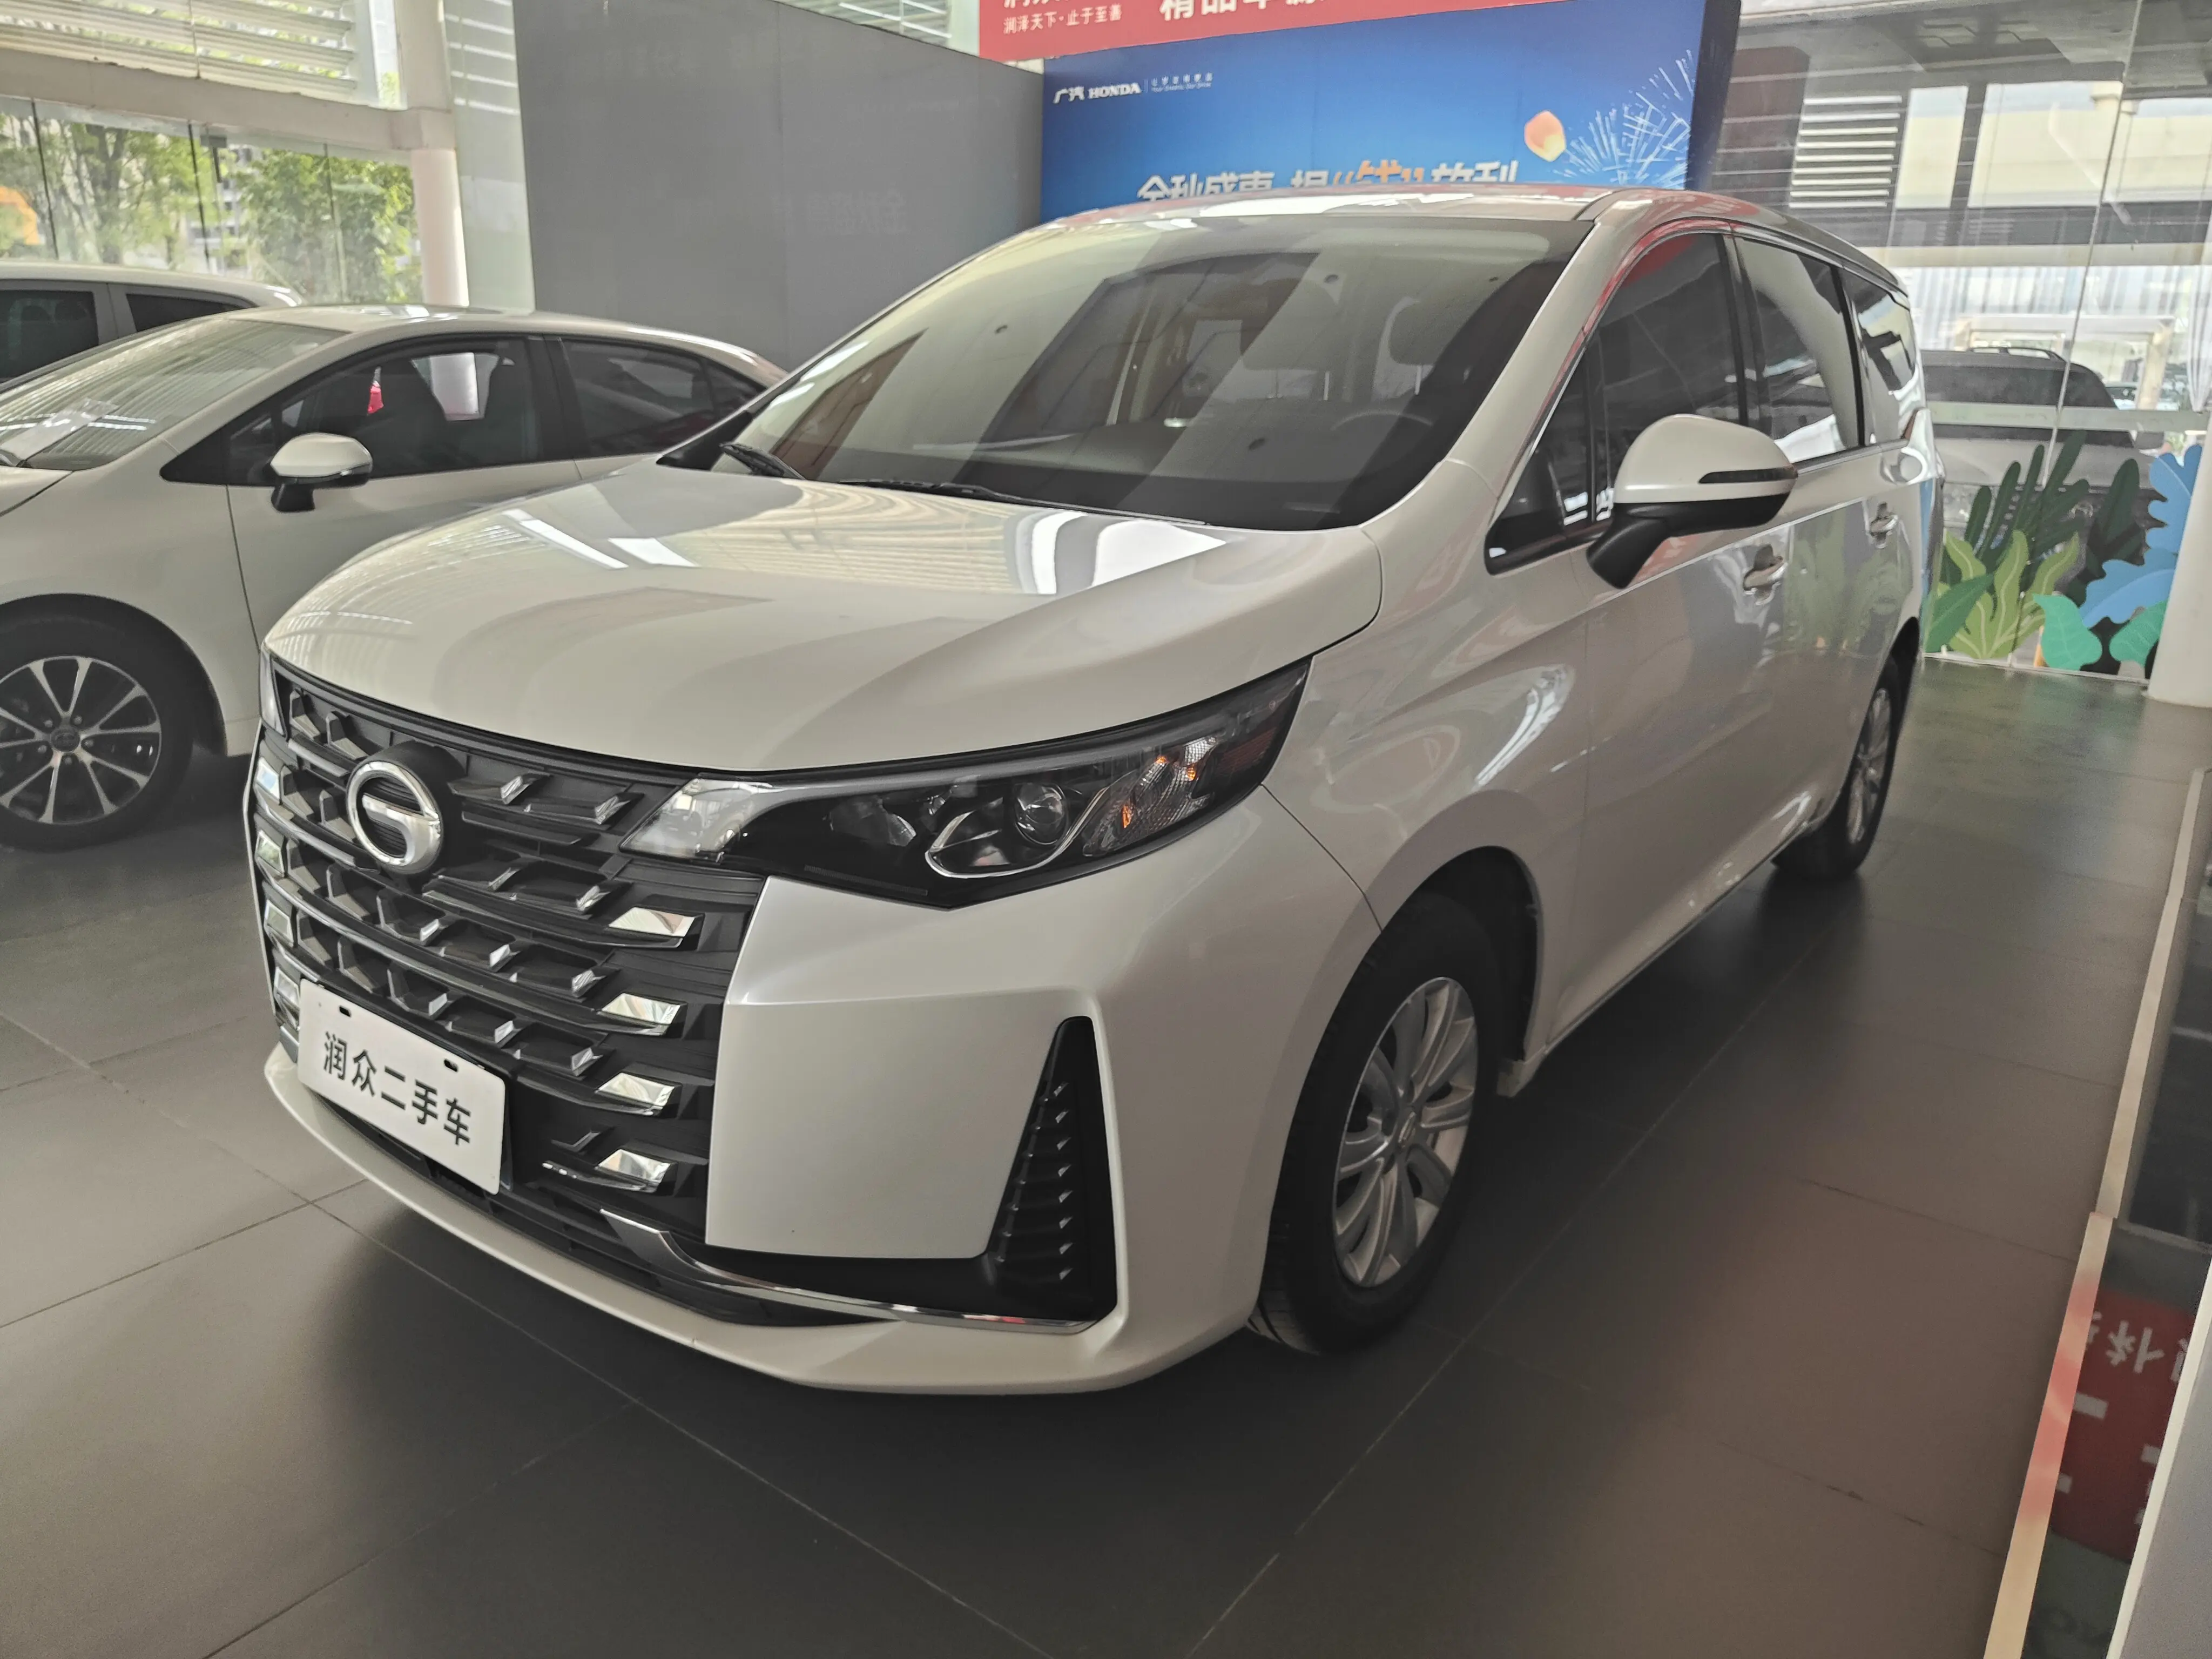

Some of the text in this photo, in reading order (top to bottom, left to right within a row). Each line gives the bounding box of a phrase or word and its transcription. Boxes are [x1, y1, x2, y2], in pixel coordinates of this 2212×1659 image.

[1053, 86, 1085, 104] 广汽
[1088, 82, 1142, 99] HONDA
[322, 1031, 471, 1145] 润众二手车
